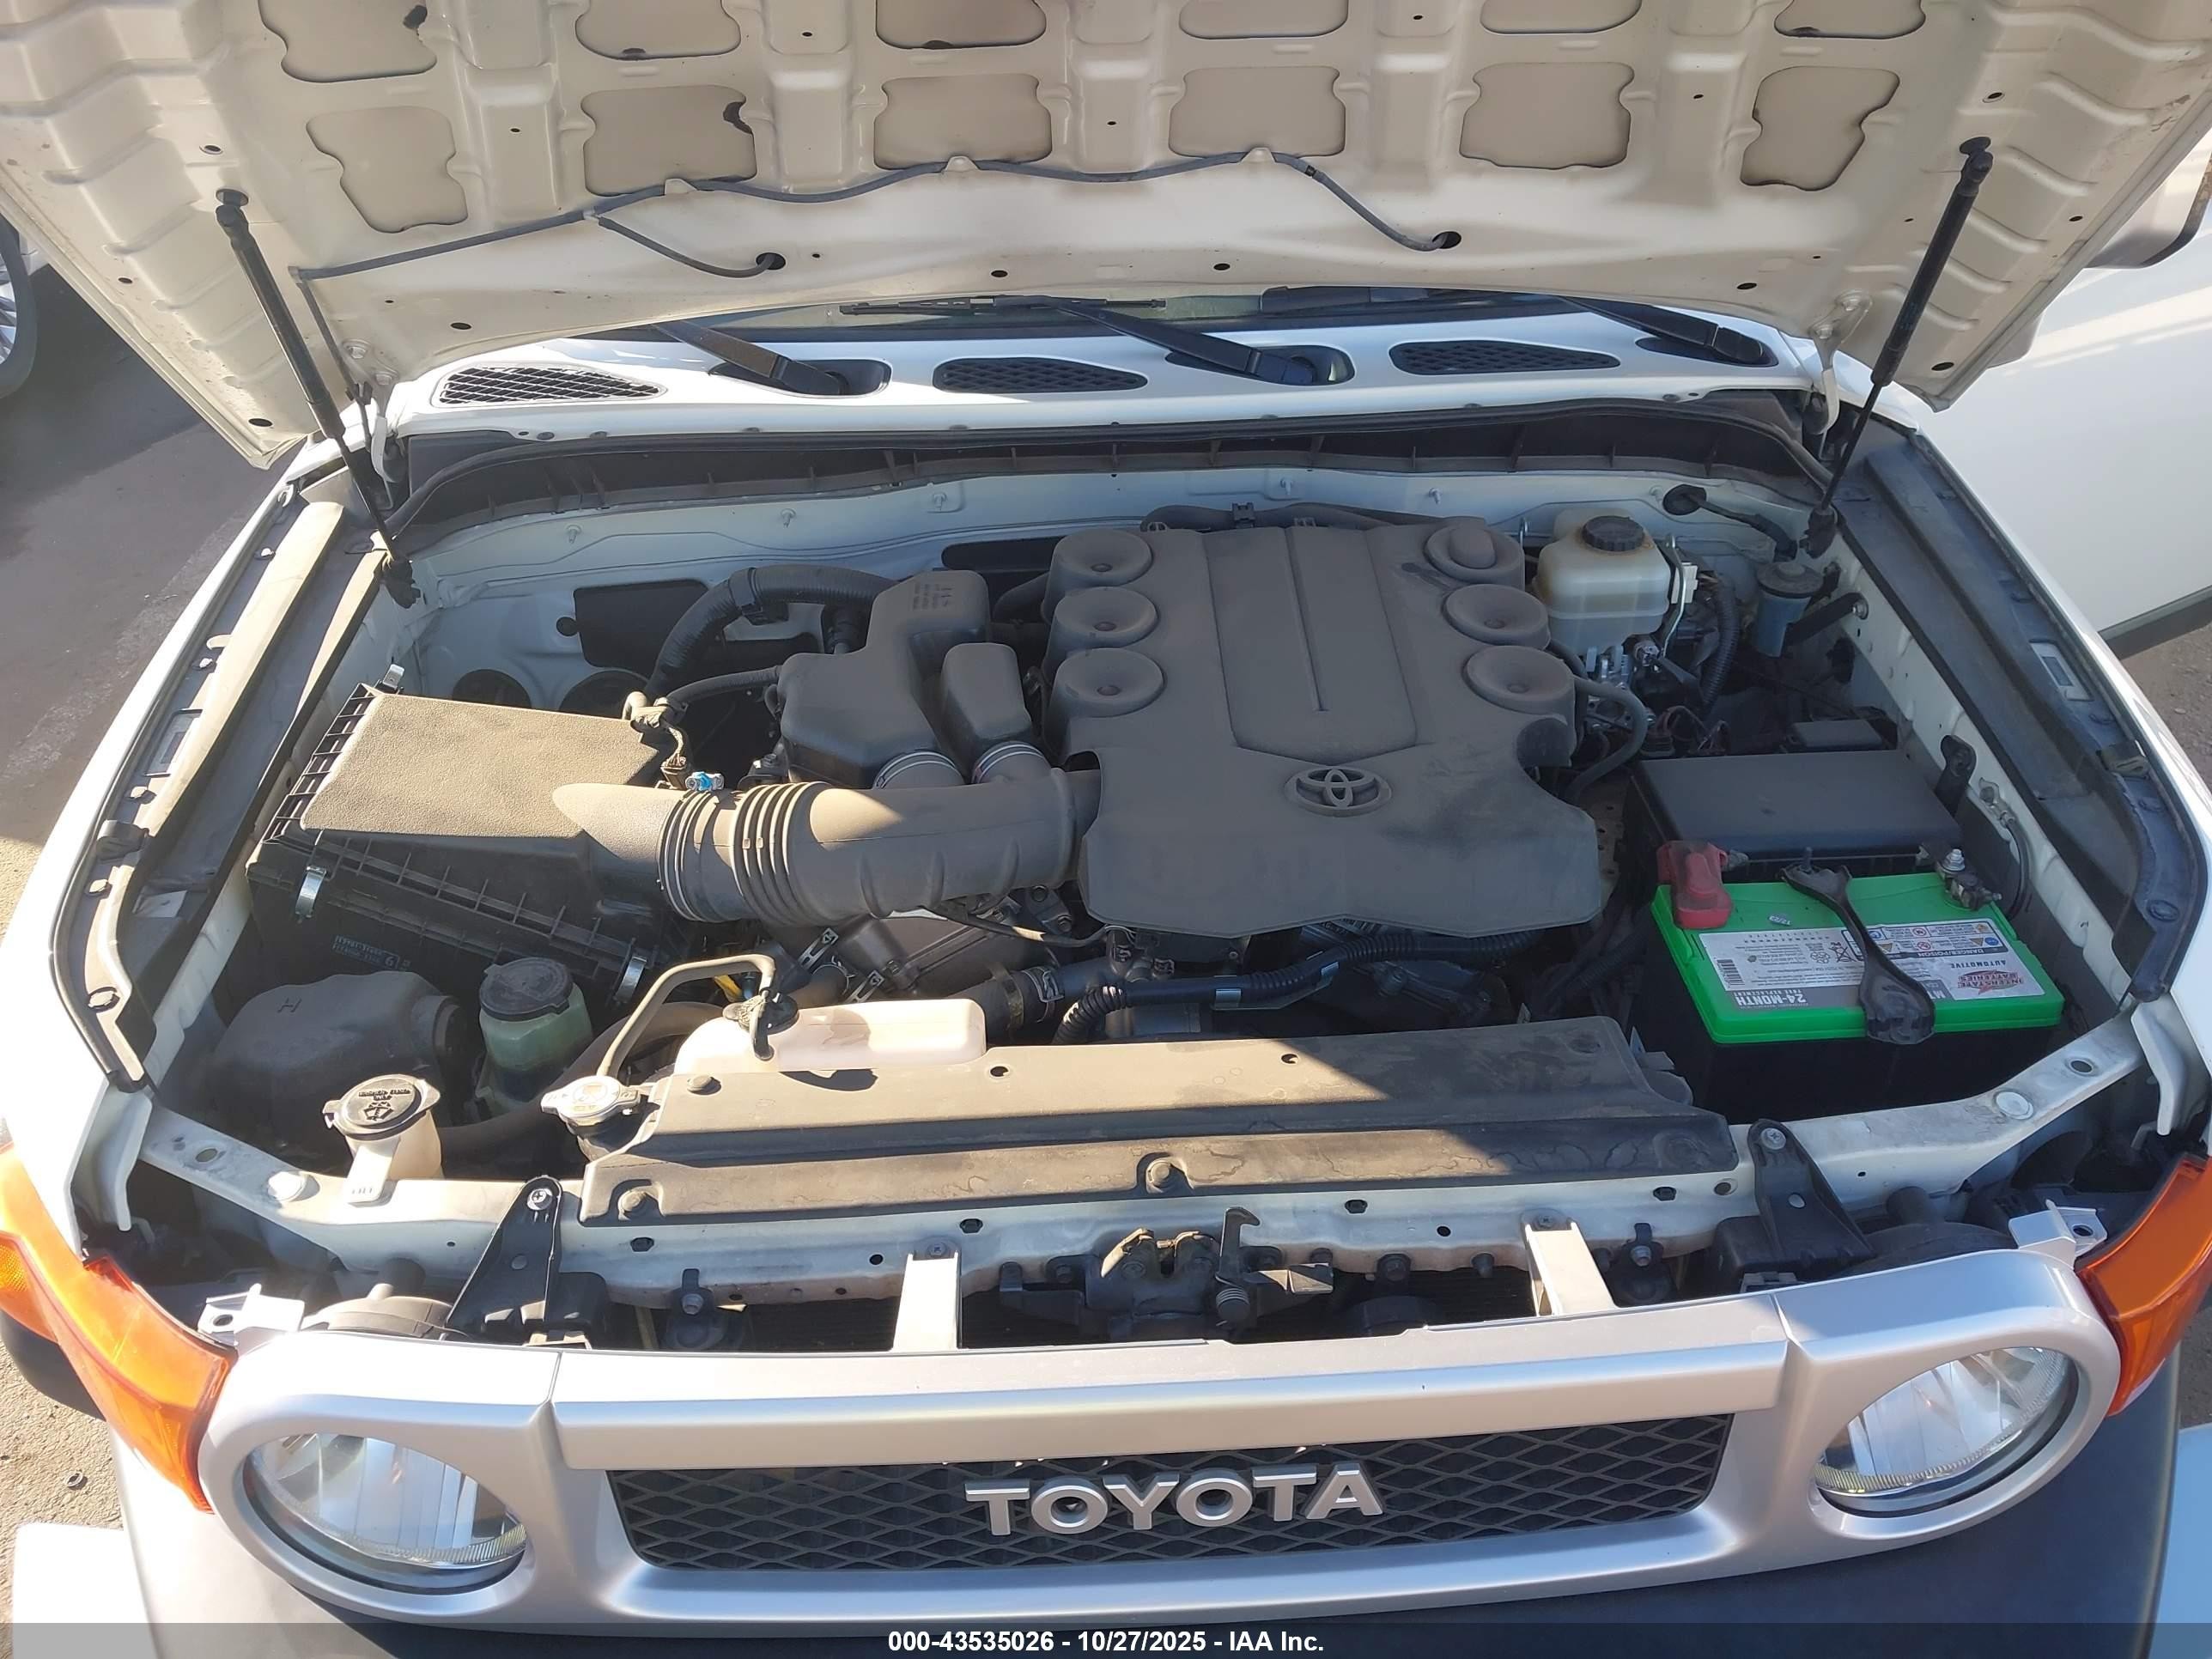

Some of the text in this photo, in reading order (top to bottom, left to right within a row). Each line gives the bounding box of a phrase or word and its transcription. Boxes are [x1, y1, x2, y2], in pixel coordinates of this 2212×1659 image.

[1917, 948, 1984, 957] DANGER/POISON
[1950, 959, 2006, 969] AUTOMOTIVE
[1959, 972, 2018, 982] BATTERIES
[1959, 977, 2022, 989] INTERSTATE
[1735, 994, 1807, 1006] 24-MONTH
[964, 1462, 1383, 1536] TOYOTA
